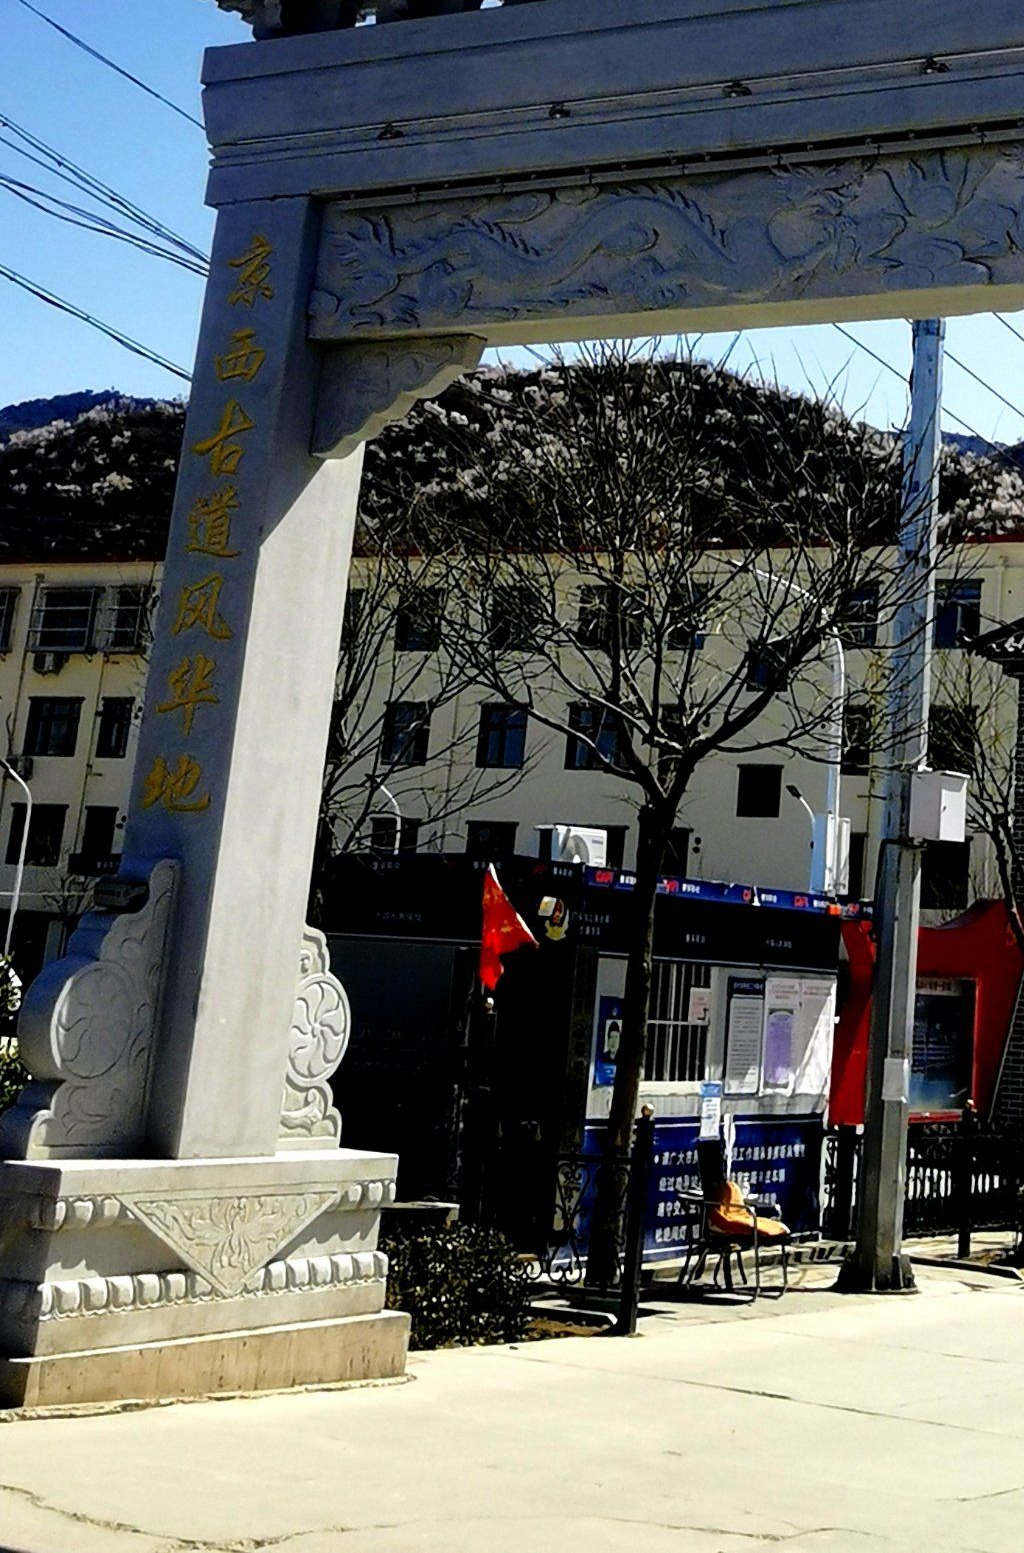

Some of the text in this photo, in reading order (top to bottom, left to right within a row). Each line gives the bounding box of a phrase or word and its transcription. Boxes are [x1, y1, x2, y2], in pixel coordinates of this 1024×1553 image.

[138, 234, 277, 814] 京西古道风华地
